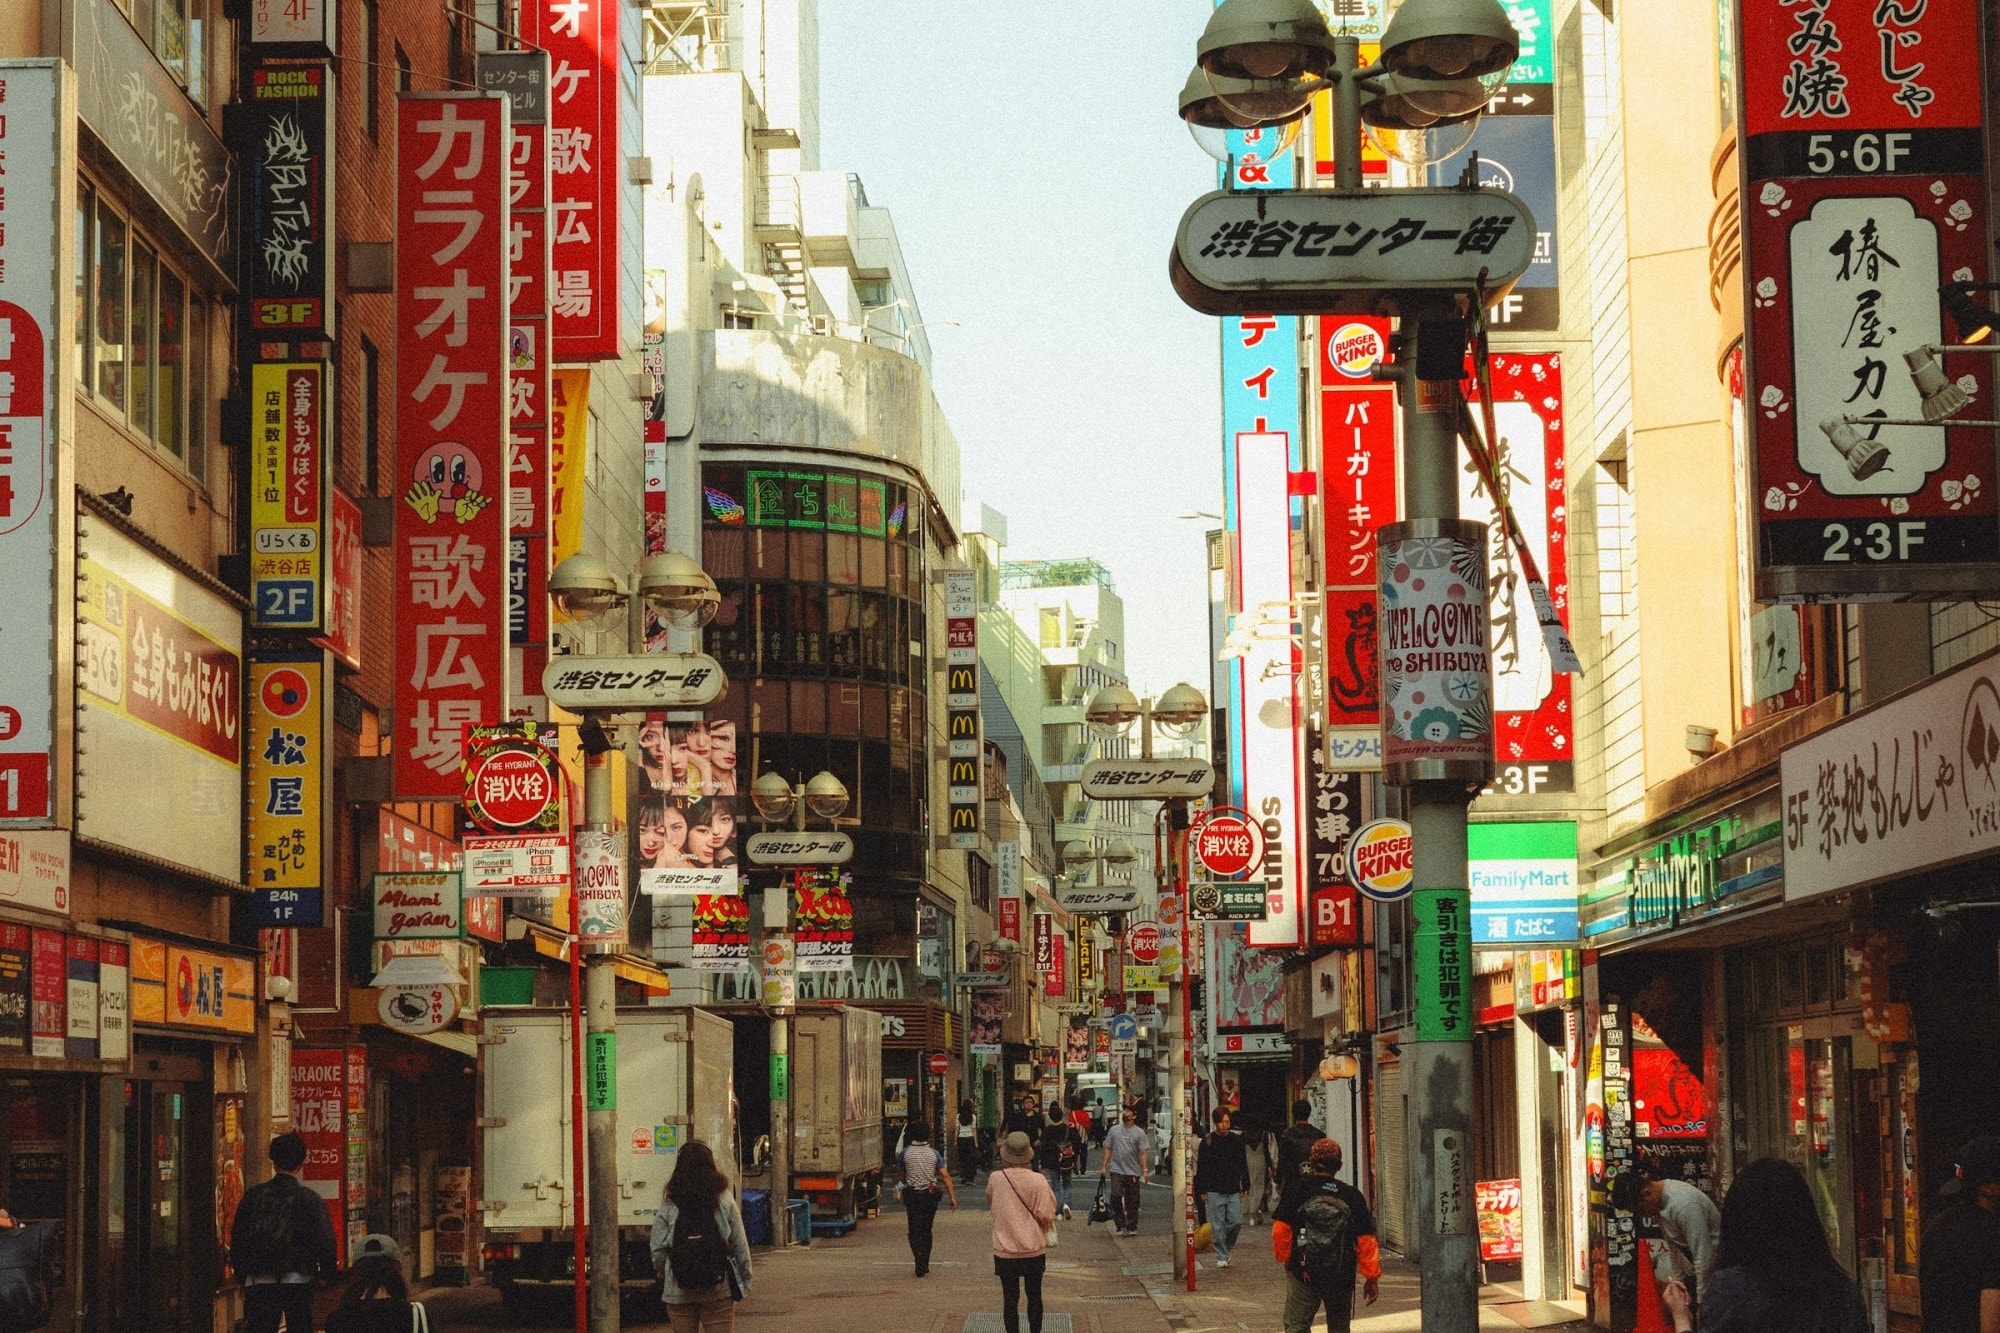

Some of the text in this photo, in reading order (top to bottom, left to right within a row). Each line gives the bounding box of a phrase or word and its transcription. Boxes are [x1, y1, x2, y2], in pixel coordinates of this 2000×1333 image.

[1780, 0, 1849, 118] み焼
[267, 71, 308, 84] ROCK
[483, 69, 540, 84] センター街
[256, 84, 319, 98] FASHION
[1200, 215, 1517, 258] 渋谷センター街
[413, 103, 489, 432] カラオケ
[260, 303, 313, 324] 3F
[1335, 334, 1376, 353] BURGER
[1336, 342, 1378, 367] KING
[292, 376, 313, 516] 全身もみほぐし
[1345, 400, 1374, 577] バーガーキング
[260, 533, 312, 549] りらくる
[260, 559, 312, 575] 渋谷店
[264, 587, 308, 616] 2F
[1386, 602, 1484, 650] WELCOME
[408, 534, 487, 776] 歌広場
[1405, 651, 1489, 673] SHIBUYA
[131, 616, 237, 741] 全身もみほぐし
[553, 668, 713, 691] 渋谷センター街
[262, 726, 308, 816] 松屋
[488, 760, 537, 771] FIRE HYDRANT
[1090, 769, 1209, 785] 渋谷センター街
[482, 772, 545, 804] 消火栓
[1816, 727, 1956, 863] 築地もんじゃ
[1787, 790, 1809, 851] 5F
[277, 835, 291, 875] カレー
[291, 828, 305, 869] 牛めし
[525, 848, 555, 856] iPhone
[752, 841, 846, 855] 渋谷センター街
[1203, 835, 1250, 857] 消火栓
[1262, 796, 1285, 915] atmos
[263, 844, 277, 882] 定食
[654, 874, 722, 884] 渋谷センター街
[1471, 870, 1570, 890] FamilyMart
[269, 890, 300, 902] 24h
[379, 890, 442, 907] Miami
[578, 889, 623, 900] SHIBUYA
[1063, 892, 1136, 904] 渋谷センター街
[1223, 892, 1265, 904] 宝石広場
[274, 906, 294, 921] 1F
[1318, 897, 1351, 927] B1
[1487, 916, 1556, 939] 酒 たばこ
[1435, 896, 1463, 1031] 客引きは犯罪です
[195, 965, 226, 1018] 松屋
